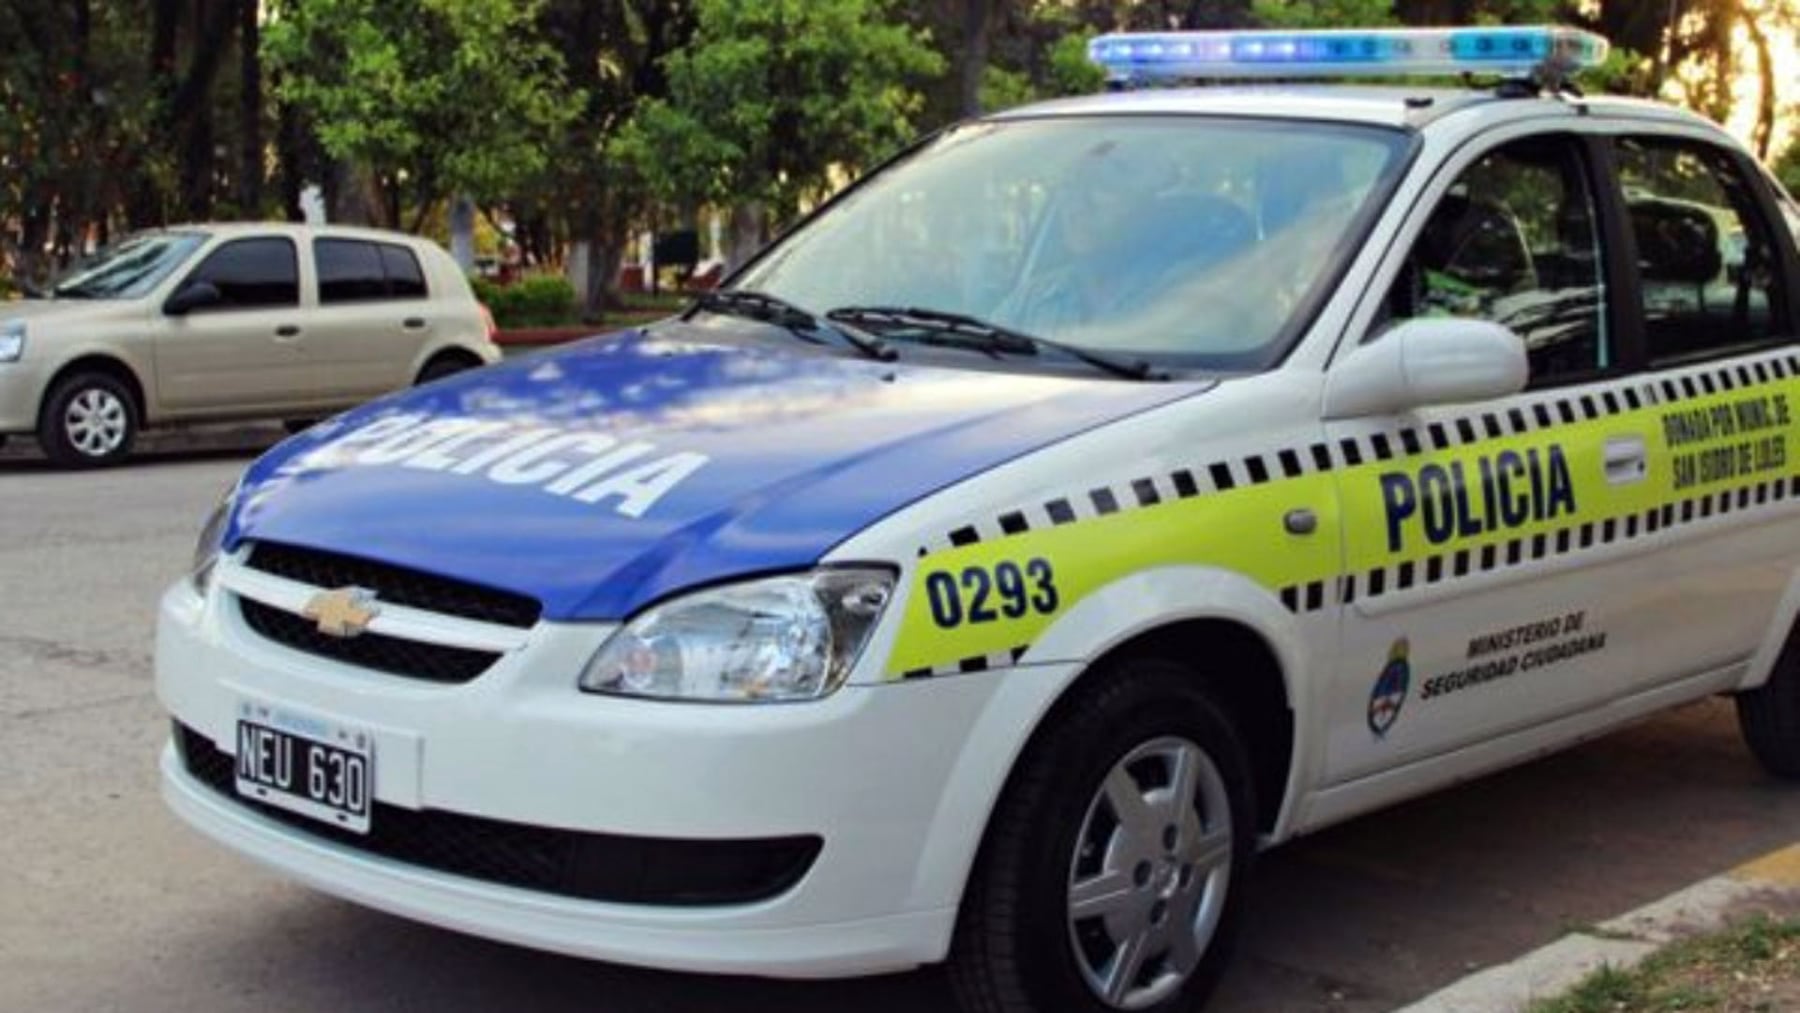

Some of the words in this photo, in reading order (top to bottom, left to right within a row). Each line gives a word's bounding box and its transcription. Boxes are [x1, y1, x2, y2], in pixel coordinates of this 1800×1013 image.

[1709, 403, 1736, 437] POR
[1773, 394, 1791, 425] DE
[277, 412, 708, 518] POLICIA
[1379, 444, 1577, 553] POLICIA
[1673, 453, 1696, 490] SAN
[1737, 441, 1752, 476] DE
[926, 557, 1060, 630] 0293
[1420, 656, 1519, 701] SEGURIDAD
[1520, 632, 1607, 672] CIUDADANA
[1467, 616, 1562, 658] MINISTERIO
[1563, 610, 1586, 634] DE
[239, 723, 292, 789] NEU
[309, 745, 364, 813] 630
